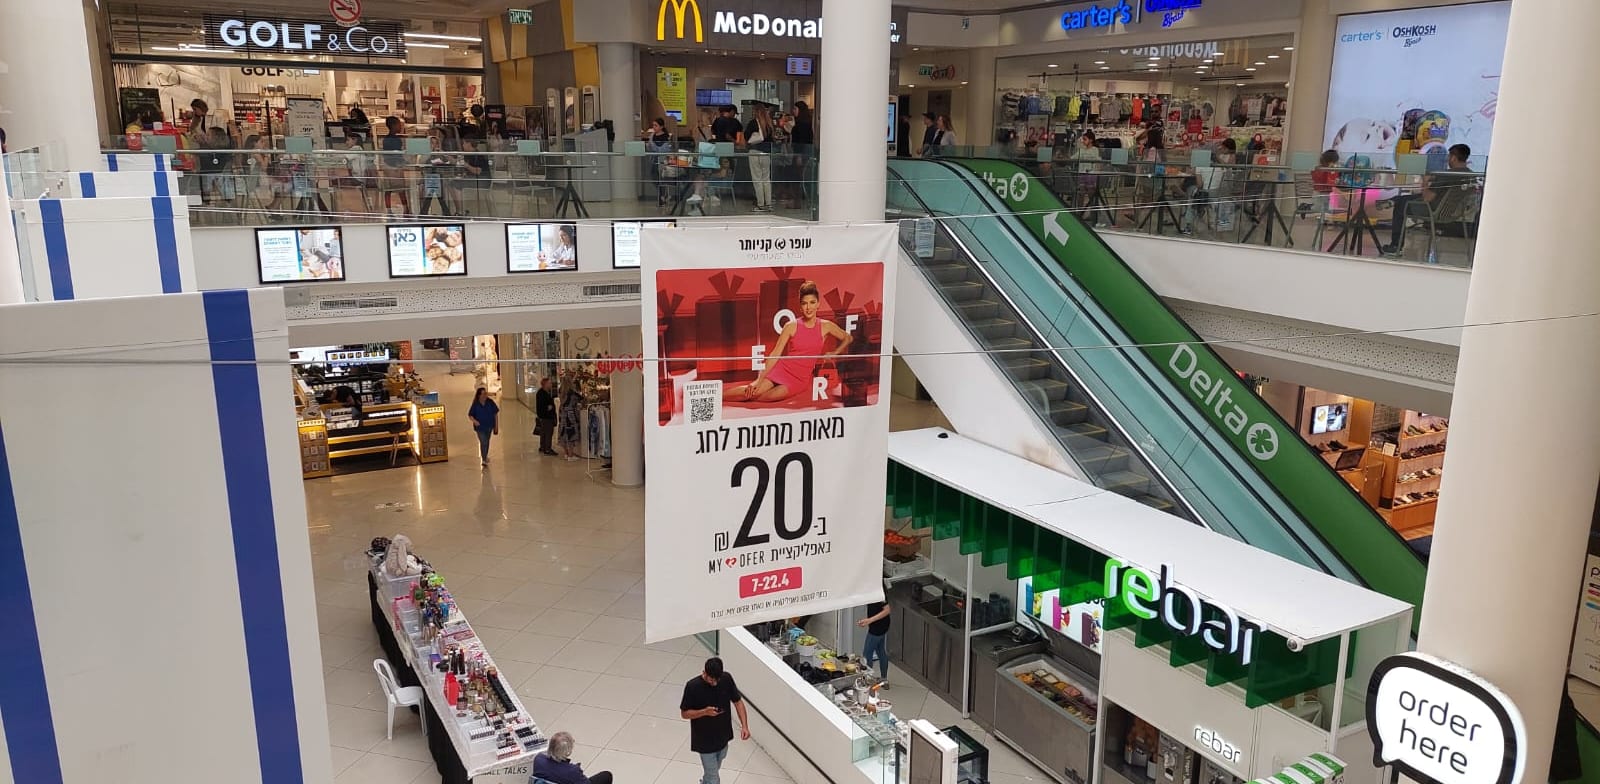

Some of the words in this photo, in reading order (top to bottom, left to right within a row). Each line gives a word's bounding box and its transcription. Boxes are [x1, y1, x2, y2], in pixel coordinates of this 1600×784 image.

[713, 12, 823, 38] McDonal
[1061, 1, 1131, 31] carter's
[220, 20, 322, 50] GOLF
[1341, 30, 1382, 43] carter's
[1393, 25, 1437, 38] OSHKOSH
[739, 239, 772, 253] קניותר
[790, 238, 812, 250] עופר
[1169, 344, 1248, 436] Delta
[696, 425, 730, 454] לחג
[736, 422, 792, 450] מתנות
[798, 416, 844, 443] מאות
[739, 551, 765, 568] OFER
[770, 541, 831, 562] באפליקציית
[708, 559, 723, 574] MY
[751, 573, 790, 592] 7-22.4
[1104, 558, 1267, 665] rebar
[1398, 690, 1482, 743] order
[1194, 728, 1241, 764] rebar
[1399, 717, 1468, 775] here
[504, 767, 528, 775] TALKS
